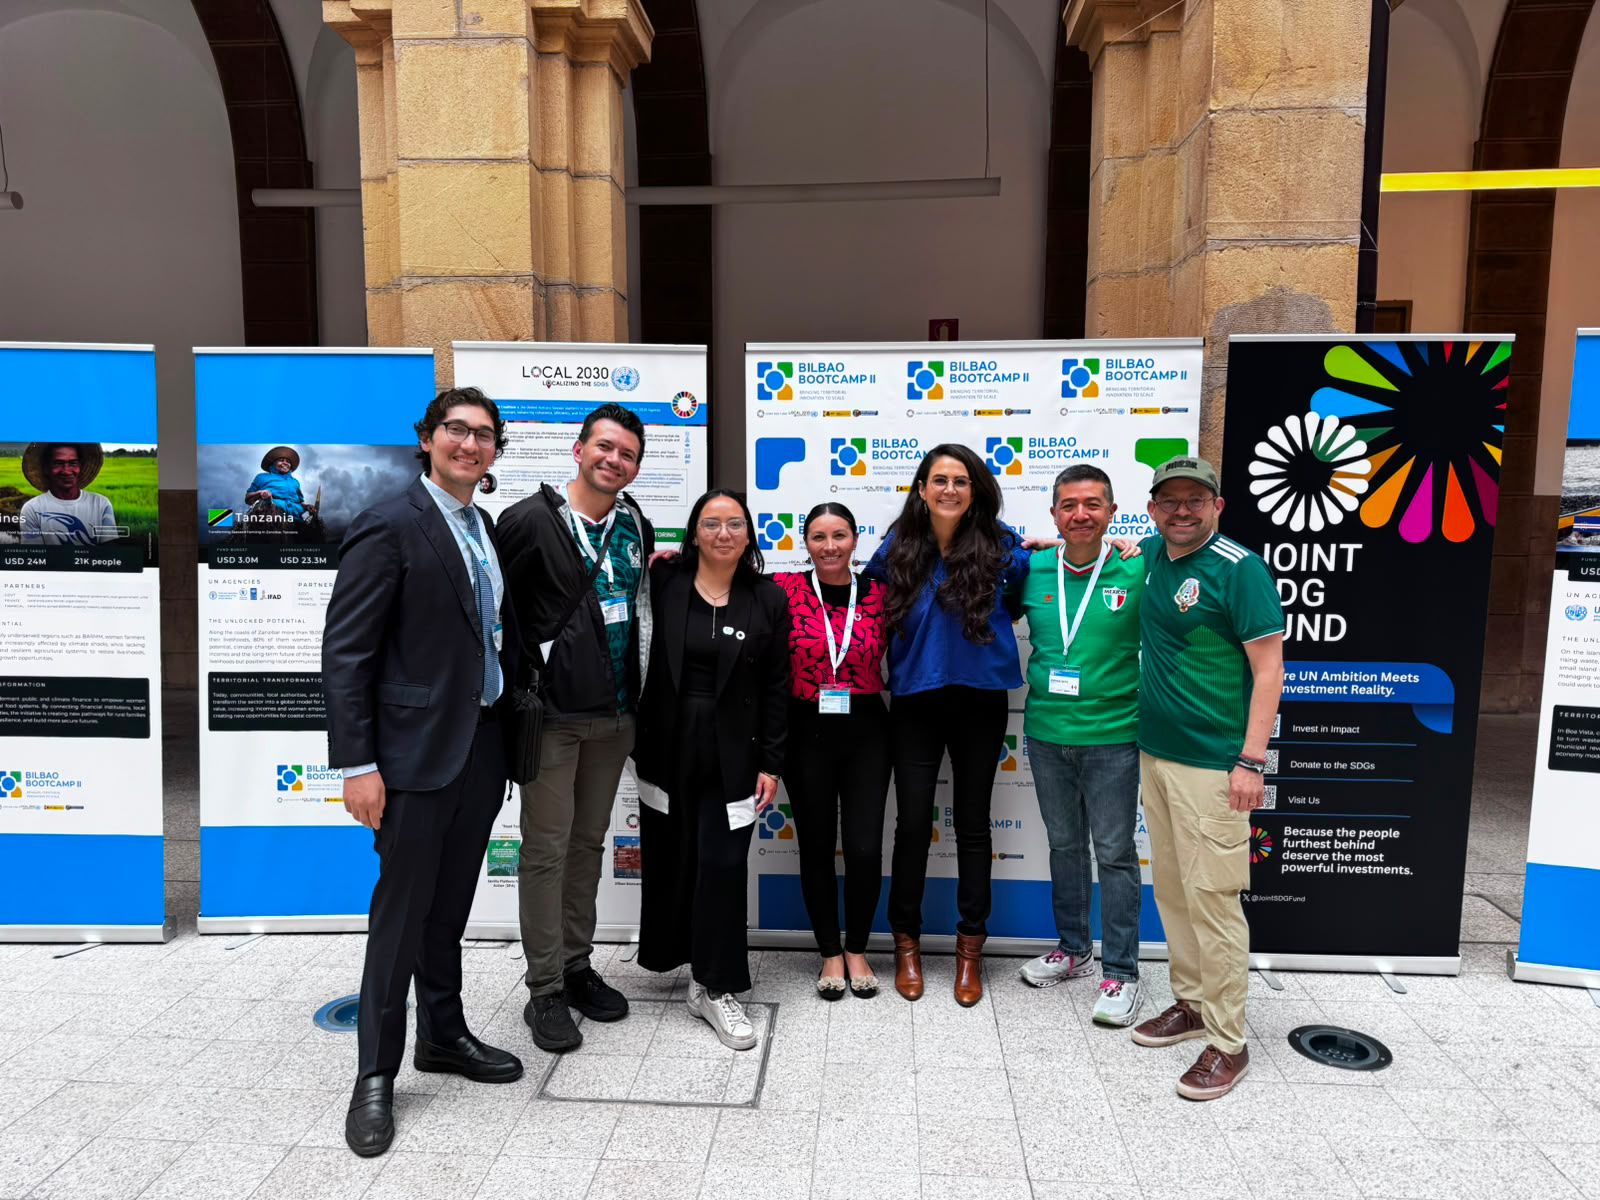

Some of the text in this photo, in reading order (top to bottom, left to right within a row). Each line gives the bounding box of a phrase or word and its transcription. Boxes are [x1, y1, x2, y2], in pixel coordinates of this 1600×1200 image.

[798, 362, 845, 373] BILBAO
[950, 361, 998, 372] BILBAO
[1106, 358, 1155, 369] BILBAO
[522, 365, 609, 379] LOCAL 2030
[950, 372, 1030, 383] BOOTCAMP II
[1105, 370, 1187, 381] BOOTCAMP II
[798, 375, 876, 384] BOOTCAMP II
[872, 438, 918, 449] BILBAO
[1029, 436, 1077, 448] BILBAO
[872, 450, 928, 460] BOOTCA
[1029, 448, 1109, 459] BOOTCAMP II
[236, 512, 294, 523] Tanzania
[1112, 514, 1149, 524] LBAO
[4, 557, 122, 566] USD 24M 21K people
[217, 556, 235, 564] USD
[237, 556, 259, 564] 3.0M
[1276, 578, 1325, 607] DG
[1282, 613, 1348, 642] UND
[1559, 657, 1578, 665] rising
[1299, 671, 1318, 682] UN
[1320, 671, 1378, 682] Ambition
[1380, 672, 1420, 683] Meets
[1558, 673, 1591, 681] managing
[1282, 684, 1396, 698] nvestment Reality.
[1292, 724, 1360, 735] Invest in Impact
[1555, 751, 1584, 759] economy
[1290, 760, 1376, 770] Donate to the SDGs
[25, 771, 59, 779] BILBAO
[25, 779, 76, 788] BOOTCAMP
[1287, 795, 1320, 805] Visit Us
[1284, 826, 1400, 839] Because the people
[1283, 838, 1375, 850] furthest behind
[1282, 850, 1384, 862] deserve the most
[1281, 861, 1414, 875] powerful investments.
[1251, 894, 1306, 902] @JointSDGFund
